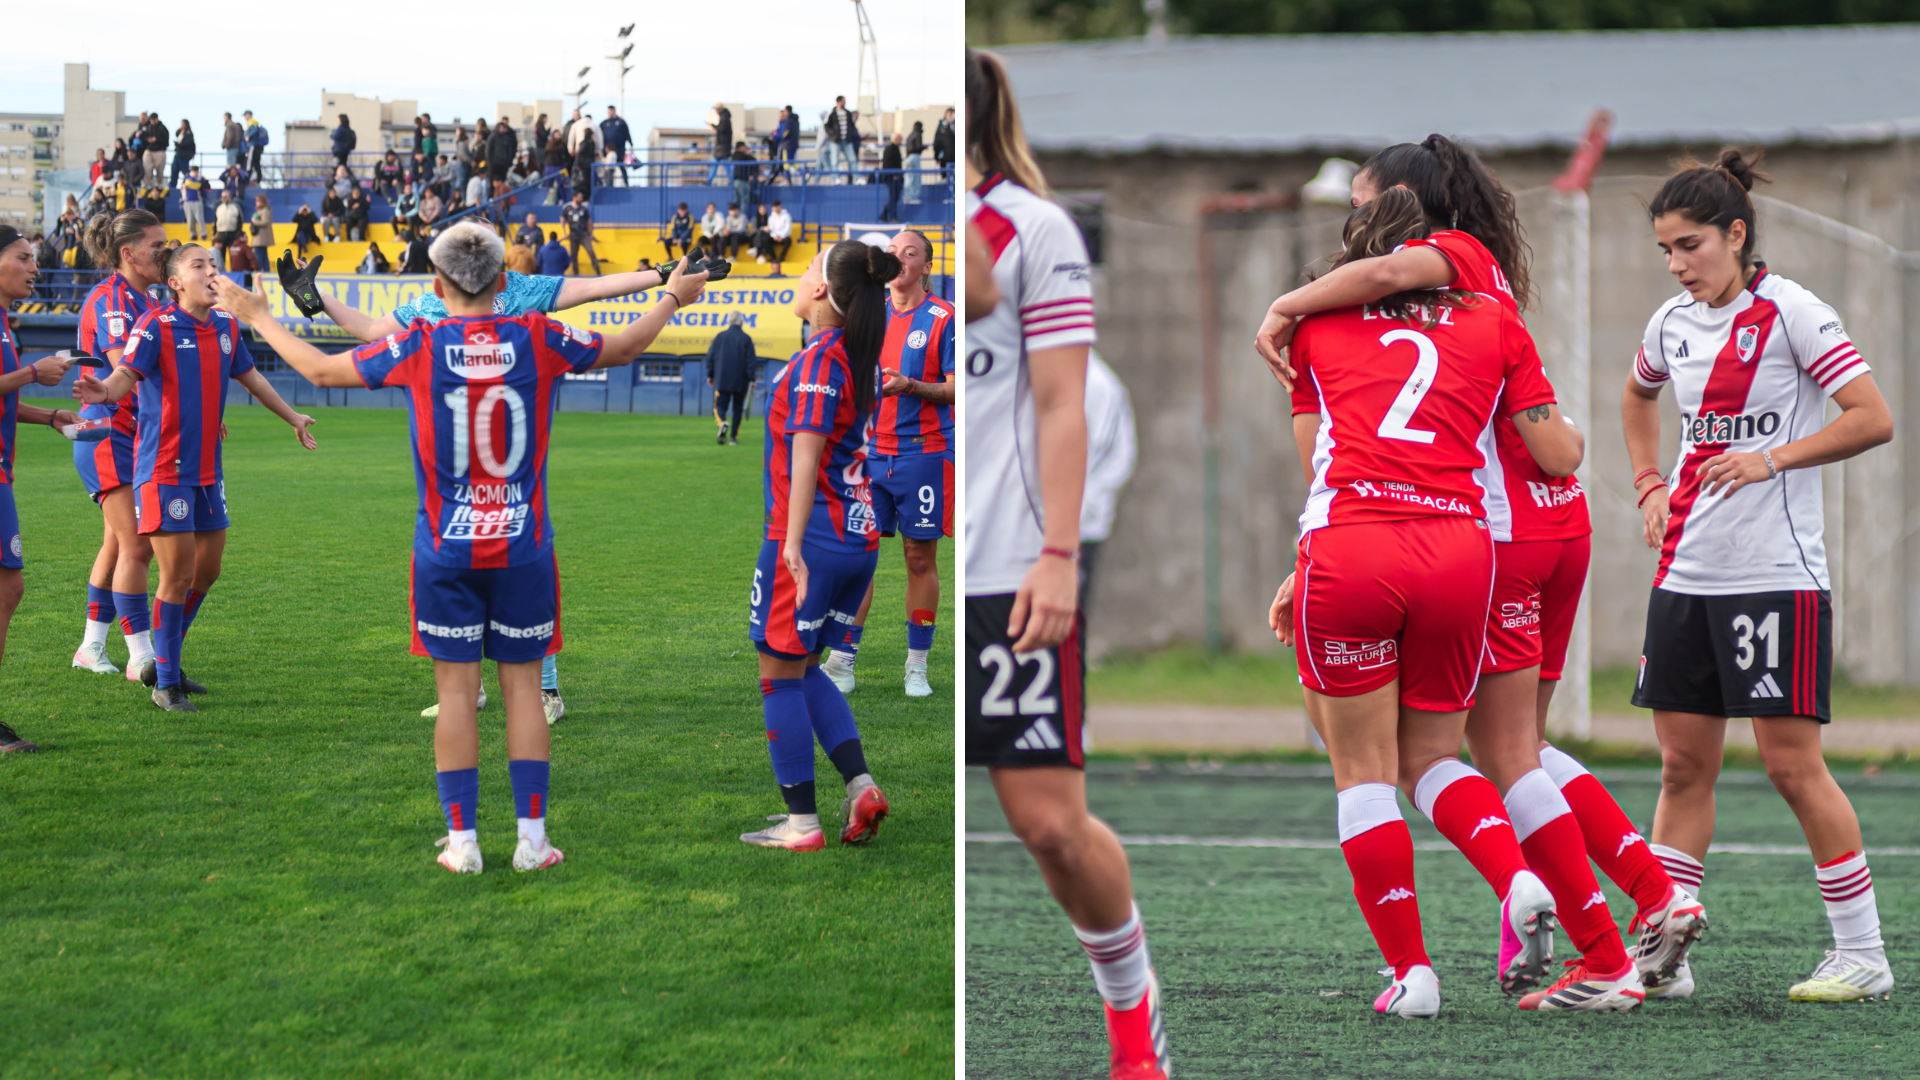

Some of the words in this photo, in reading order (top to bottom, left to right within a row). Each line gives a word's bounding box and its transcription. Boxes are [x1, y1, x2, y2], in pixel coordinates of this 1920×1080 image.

[589, 311, 758, 328] HURNGHM
[450, 347, 512, 367] Marolio
[1377, 329, 1439, 444] 2
[444, 385, 527, 478] 10
[454, 482, 522, 505] ZACMON
[1382, 481, 1416, 493] TIENDA
[918, 485, 935, 515] 9
[451, 503, 529, 523] flecha
[446, 521, 521, 538] BUS
[1732, 612, 1780, 671] 31
[978, 643, 1058, 716] 22
